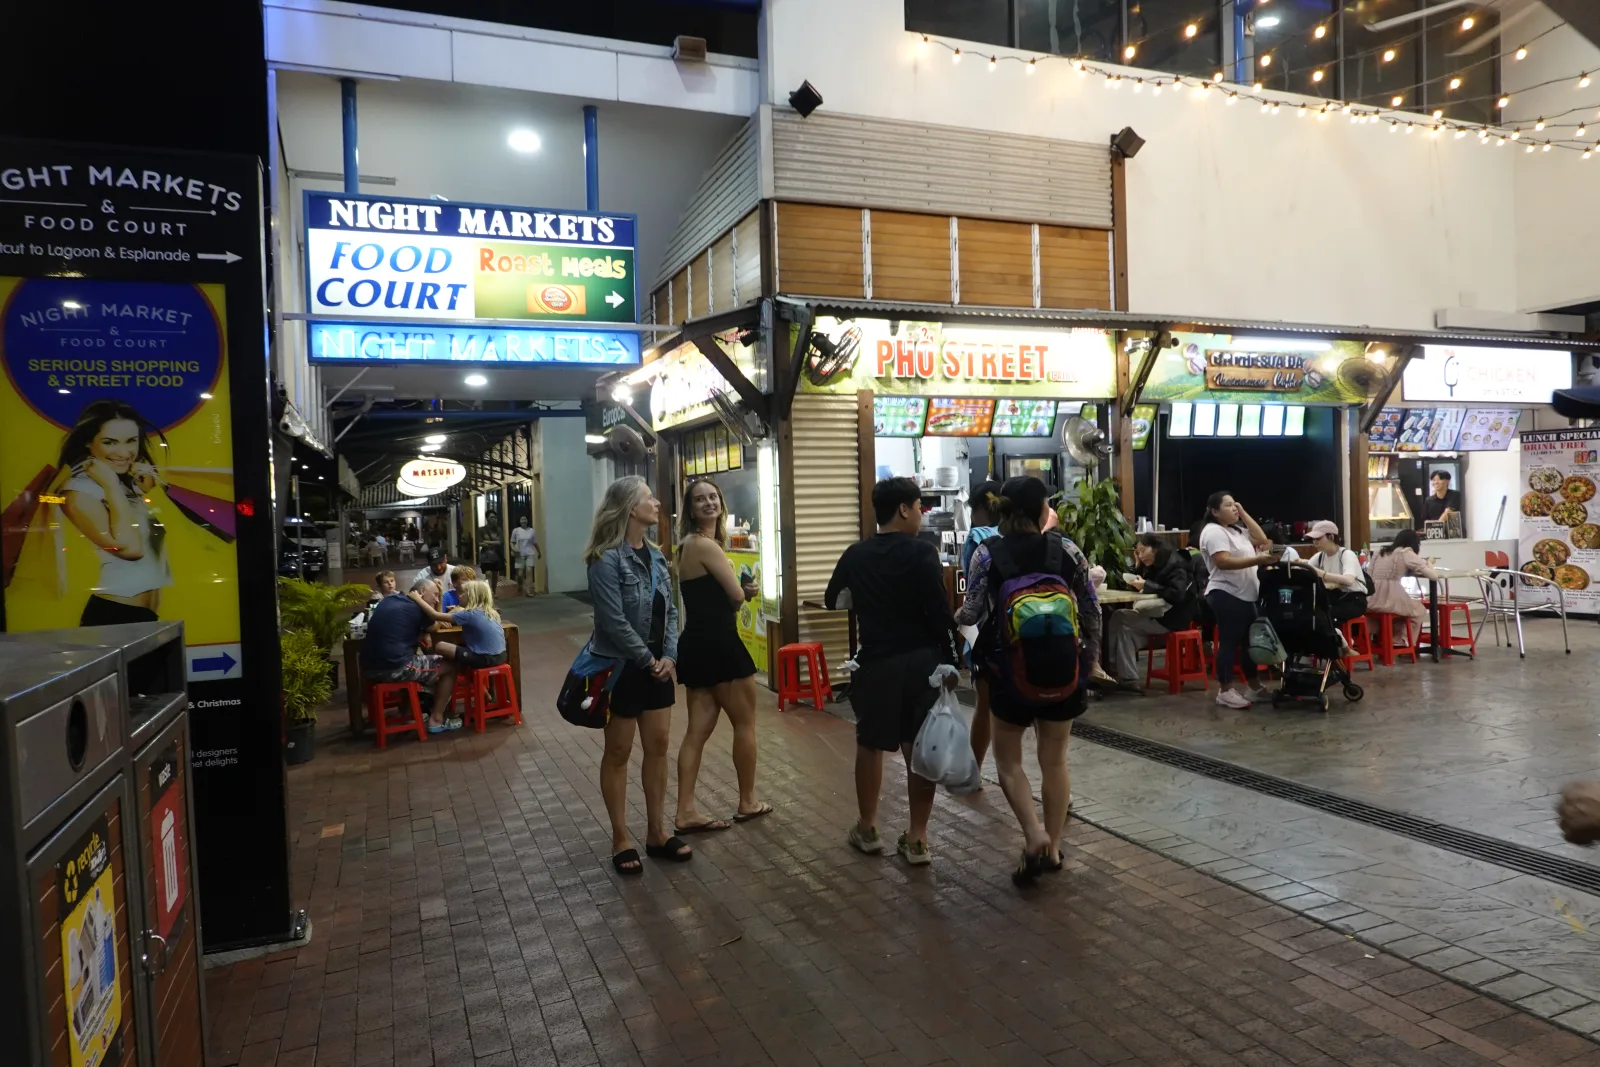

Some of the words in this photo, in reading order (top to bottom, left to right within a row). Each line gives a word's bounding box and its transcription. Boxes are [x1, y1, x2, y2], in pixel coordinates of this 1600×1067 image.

[88, 165, 242, 212] MARKETS
[100, 199, 116, 214] &
[24, 215, 94, 231] FOOD
[107, 220, 187, 236] COURT
[327, 199, 441, 232] NIGHT
[458, 208, 616, 243] MARKETS
[29, 243, 44, 255] to
[48, 244, 100, 260] Lagoon
[104, 246, 116, 259] &
[120, 247, 191, 262] Esplanade
[329, 241, 453, 274] FOOD
[479, 248, 555, 276] Roast
[316, 277, 468, 311] COURT
[20, 304, 91, 328] NIGHT
[101, 304, 193, 326] MARKET
[109, 326, 119, 336] &
[60, 338, 106, 347] FOOD
[113, 339, 168, 348] COURT
[321, 329, 436, 360] NIGHT
[446, 333, 606, 362] MARKETS
[28, 359, 107, 372] SERIOUS
[111, 360, 200, 373] SHOPPING
[942, 341, 1049, 379] STREET
[47, 375, 60, 387] &
[64, 375, 132, 387] STREET
[136, 375, 184, 387] FOOD
[1467, 366, 1536, 382] CHICKEN
[1522, 433, 1557, 443] LUNCH
[1523, 442, 1557, 451] DRINK
[1560, 441, 1588, 449] FREE
[412, 468, 455, 476] MATSURI
[1426, 528, 1444, 539] OPEN
[197, 699, 241, 708] Christmas
[196, 748, 238, 758] designers
[205, 757, 238, 767] delights
[77, 832, 100, 874] recycle
